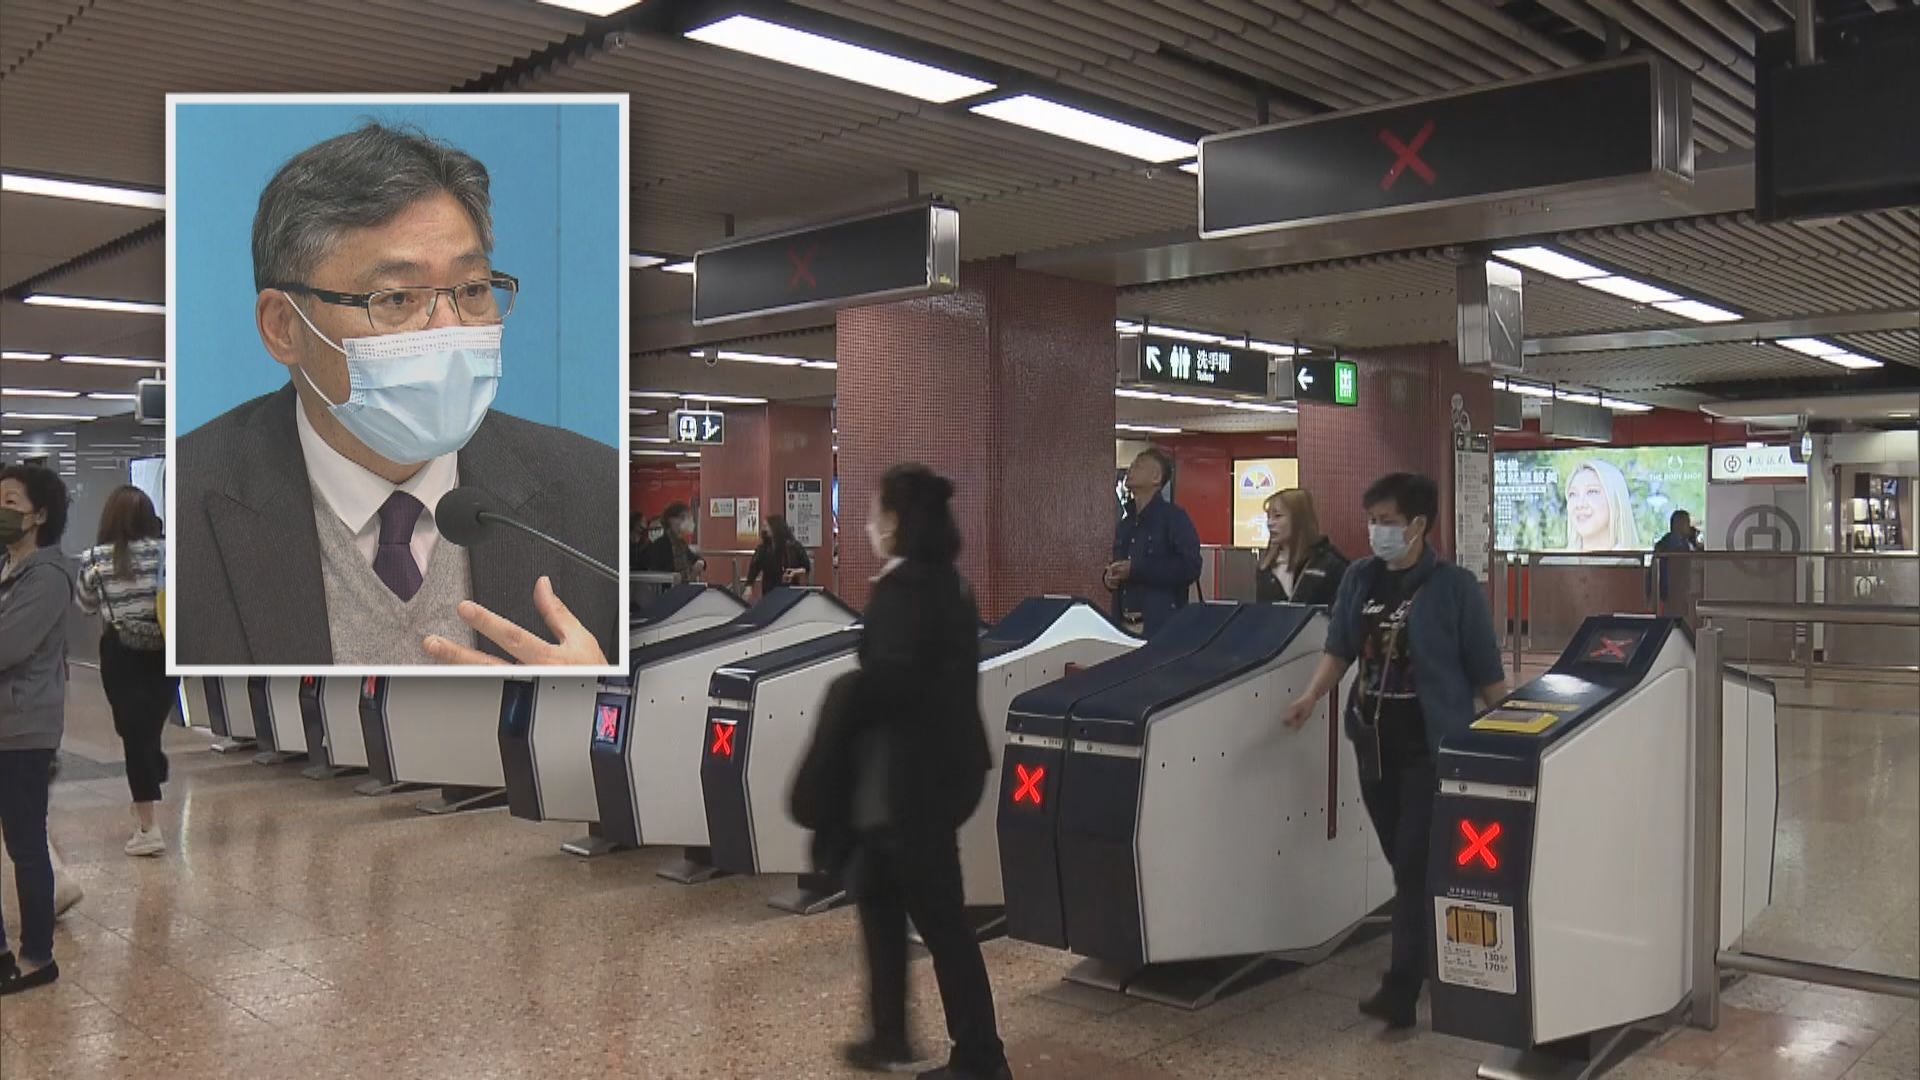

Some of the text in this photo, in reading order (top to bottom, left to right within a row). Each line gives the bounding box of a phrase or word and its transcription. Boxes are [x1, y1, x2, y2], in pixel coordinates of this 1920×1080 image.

[1196, 349, 1230, 374] 洗手間
[1339, 368, 1352, 388] 出
